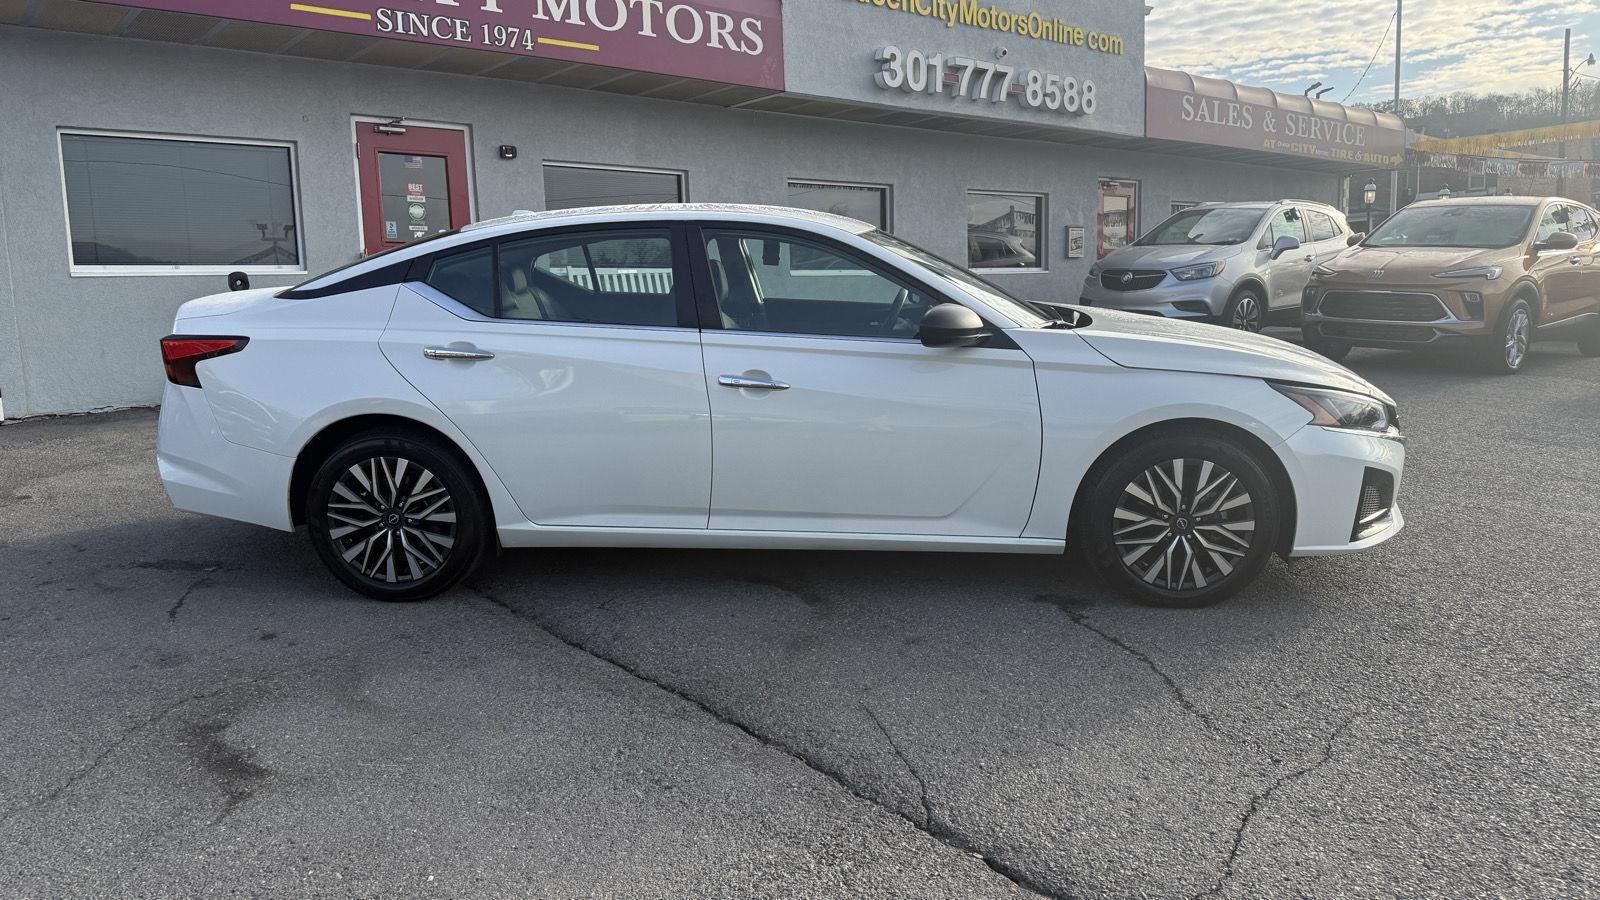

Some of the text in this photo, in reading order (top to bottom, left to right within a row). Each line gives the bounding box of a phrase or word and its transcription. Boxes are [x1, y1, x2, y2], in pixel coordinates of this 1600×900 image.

[376, 7, 535, 51] SINCE 1974
[1181, 95, 1366, 147] SALES & SERVICE
